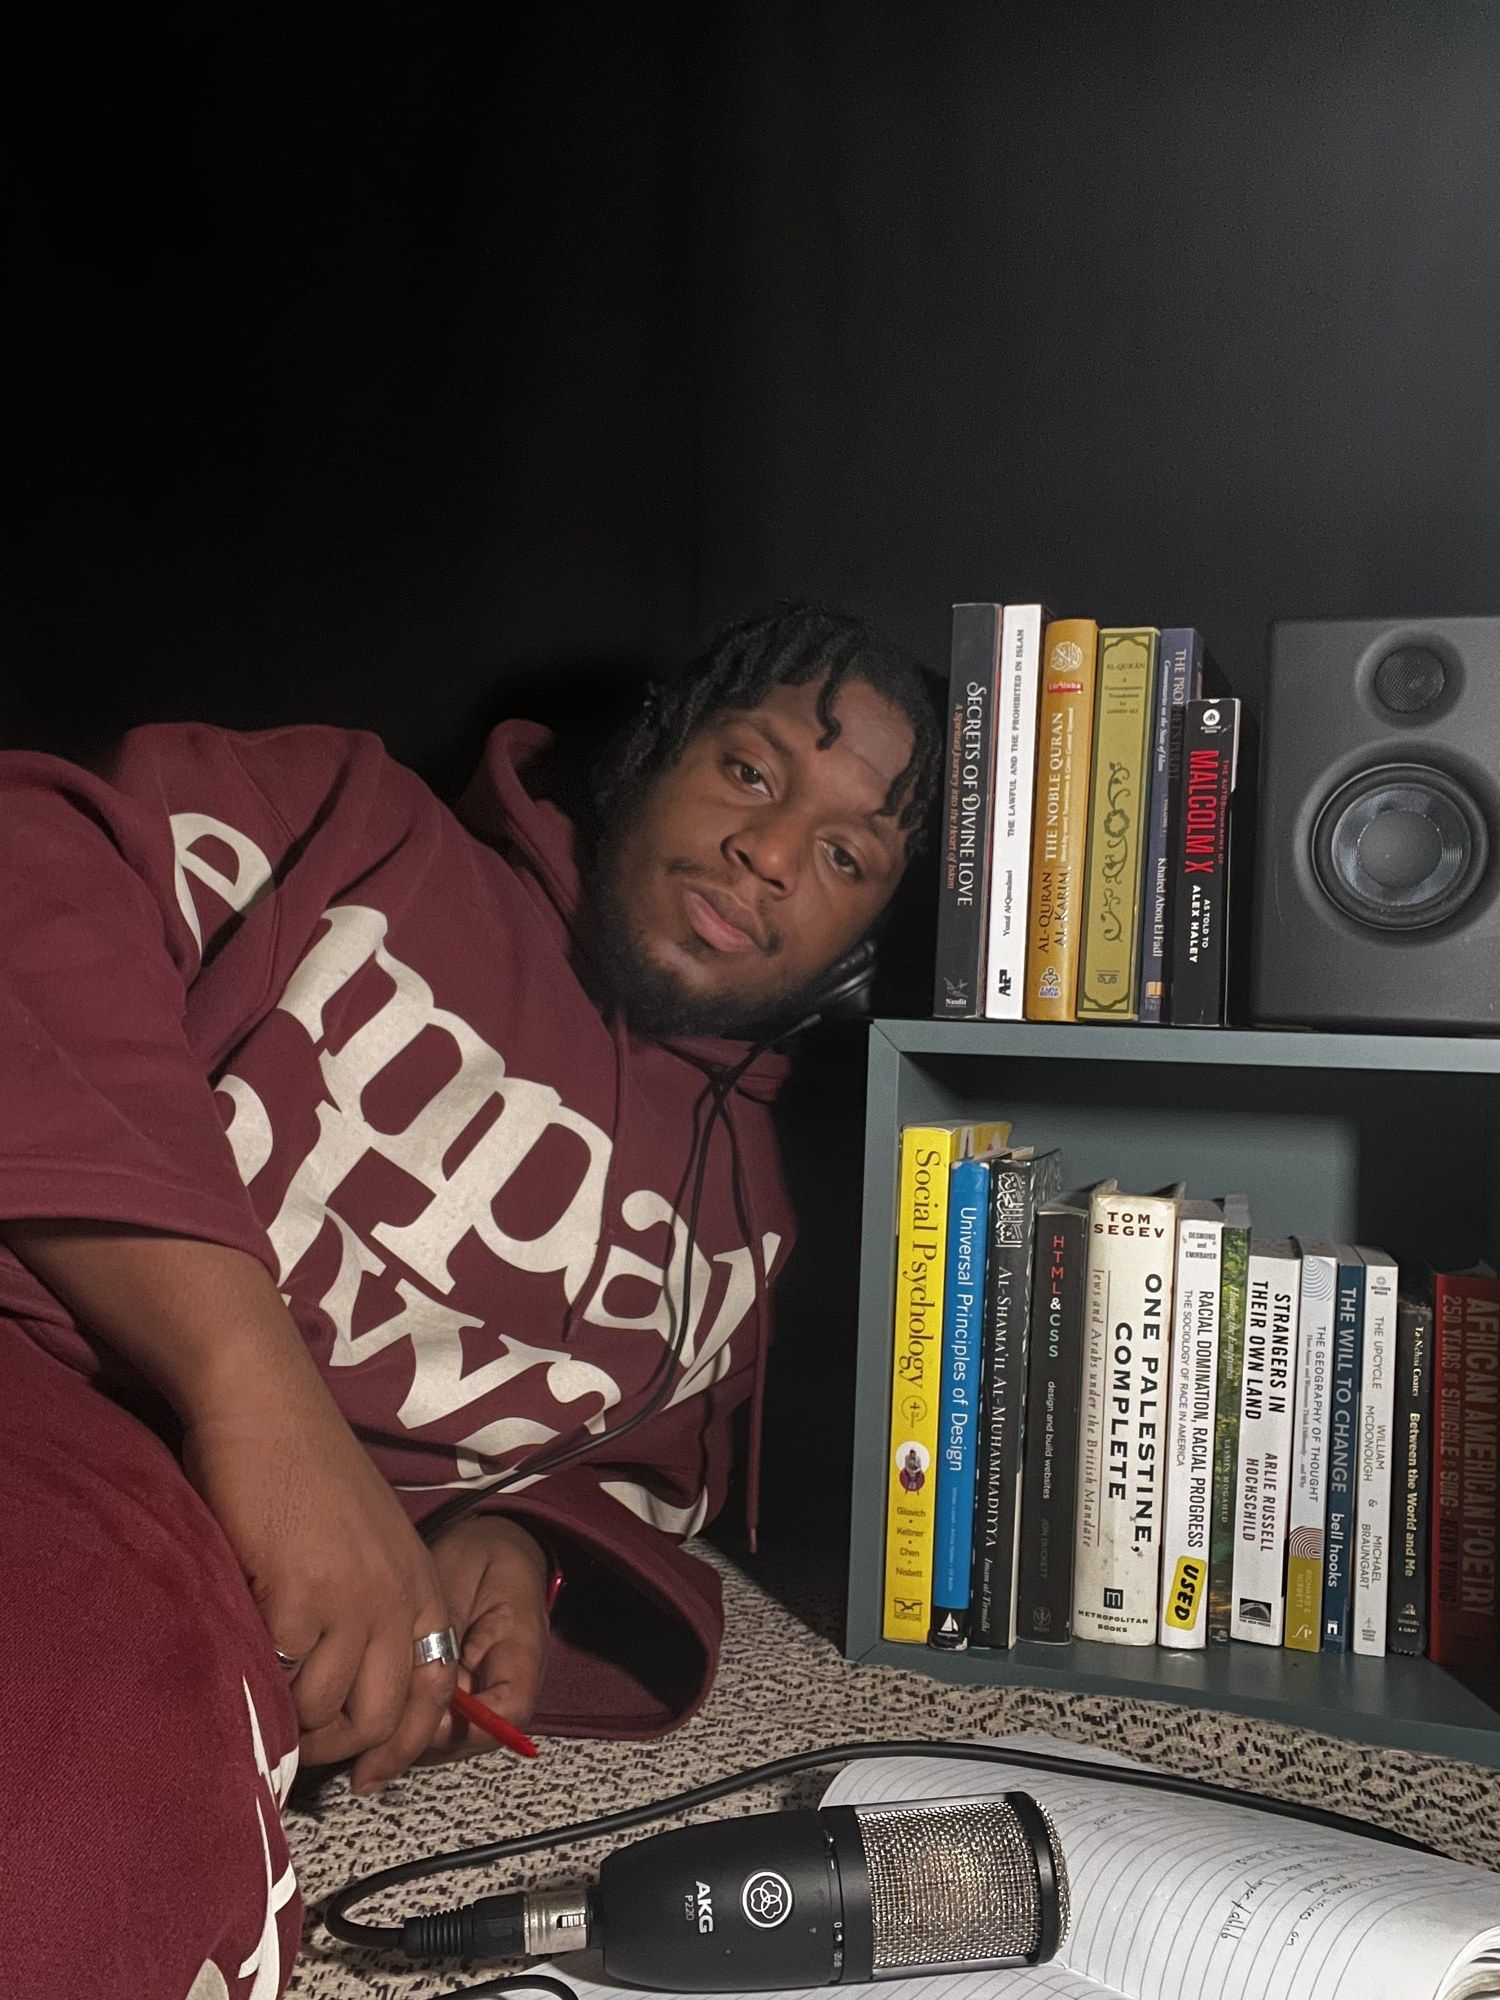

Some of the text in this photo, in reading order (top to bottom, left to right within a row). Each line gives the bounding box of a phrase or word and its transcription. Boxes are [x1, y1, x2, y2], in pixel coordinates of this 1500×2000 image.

[1173, 648, 1187, 673] THE
[951, 713, 963, 751] Spiritual
[1007, 629, 1024, 837] THE LAWFUL AND THE PROHIBITED IN ISLAM
[949, 750, 961, 786] Journey
[949, 789, 959, 806] into
[957, 681, 987, 906] SECRETS OF DIVINE LOVE
[1044, 712, 1063, 862] THE NOBLE QURAN
[1185, 750, 1220, 854] MALCOLM
[947, 825, 958, 849] Heart
[948, 809, 959, 823] the
[946, 852, 957, 862] of
[946, 865, 957, 889] Islam
[1184, 860, 1214, 875] X
[1038, 871, 1052, 953] AL-QURAN
[1053, 871, 1070, 947] AL-KARIM
[1152, 857, 1168, 957] Khaled Abou El Fadl
[1189, 885, 1201, 963] ALEX HALEY
[1201, 899, 1211, 949] AS TOLD TO
[957, 1207, 977, 1286] Universal
[1093, 1224, 1165, 1238] SEGEV
[1107, 1211, 1151, 1225] TOM
[898, 1148, 942, 1389] Social Psychology
[951, 1293, 973, 1381] Principles
[1442, 1294, 1462, 1323] 250
[1176, 1290, 1193, 1467] THE SOCIOLOGY OF RACE IN AMERICA
[1245, 1281, 1268, 1420] THEIR OWN LAND
[1268, 1293, 1291, 1413] STRANGERS IN
[1372, 1317, 1385, 1389] THE UPCYCLE
[1412, 1368, 1422, 1397] Coates
[1441, 1328, 1461, 1369] YEARS
[951, 1386, 969, 1407] of
[1083, 1269, 1104, 1548] Jews and Arabs under the British Mandate
[1108, 1322, 1133, 1500] COMPLETE
[1130, 1273, 1163, 1553] ONE PALESTINE,
[1187, 1290, 1214, 1548] RACIAL DOMINATION, RACIAL PROGRESS
[1308, 1325, 1326, 1502] THE GEOGRAPHY OF THOUGHT
[1331, 1287, 1356, 1493] THE WILL TO CHANGE
[1440, 1387, 1461, 1456] STRUGGLE
[946, 1412, 968, 1472] Design
[1042, 1381, 1056, 1500] design and build websites
[1364, 1405, 1375, 1482] MCDONOUGH
[1375, 1424, 1386, 1470] WILLIAM
[1461, 1297, 1499, 1617] AFRICAN AMERICAN POETRY
[896, 1507, 926, 1519] Gilovich
[1242, 1458, 1259, 1541] HOCHSCHILD
[1260, 1452, 1278, 1552] ARLIE RUSSELL
[1368, 1498, 1378, 1507] &
[1404, 1412, 1421, 1577] Between the World and Me
[1440, 1470, 1460, 1508] SONG
[899, 1547, 920, 1558] Chen
[1328, 1513, 1345, 1588] bell hooks
[1360, 1523, 1371, 1590] BRAUNGART
[1371, 1535, 1382, 1583] MICHAEL
[1078, 1610, 1149, 1624] METROPOLITAN
[1174, 1563, 1200, 1621] USED
[1097, 1624, 1128, 1633] BOOKS
[684, 1894, 695, 1921] P220
[695, 1880, 714, 1934] AKG
